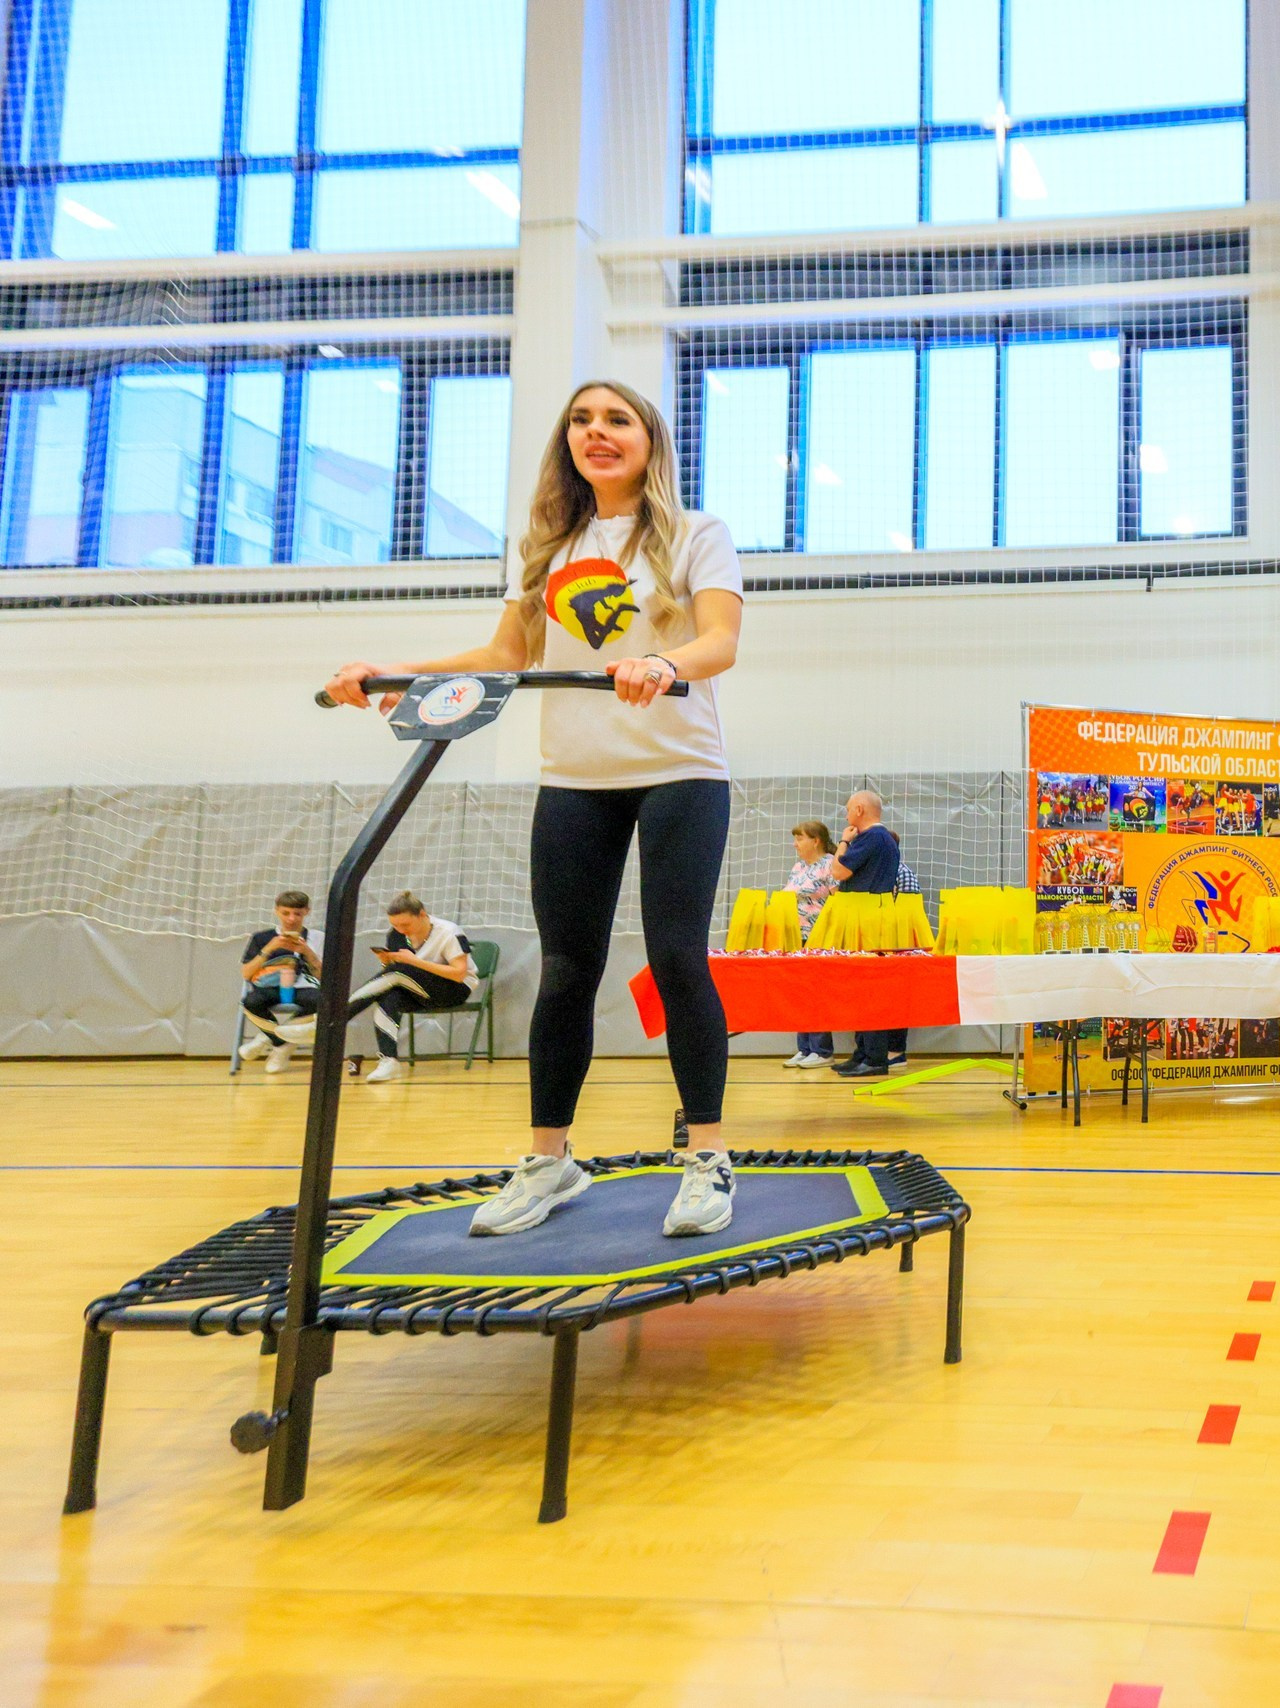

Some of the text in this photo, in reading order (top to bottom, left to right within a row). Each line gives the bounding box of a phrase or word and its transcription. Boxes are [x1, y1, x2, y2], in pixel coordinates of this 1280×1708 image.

[1077, 721, 1179, 746] ФЕДЕРАЦИЯ
[1181, 727, 1274, 751] ДЖАМПИНГ
[1137, 751, 1221, 776] ТУЛЬСКОЙ
[1148, 859, 1178, 909] ФЕДЕРАЦИЯ
[1179, 845, 1230, 862] ДЖАМПИНГ
[1231, 849, 1266, 877] ФИТНЕСА
[1265, 877, 1278, 897] РОСС
[1057, 886, 1084, 894] КУБОК
[1148, 1066, 1211, 1080] "ФЕДЕРАЦИЯ
[1213, 1064, 1268, 1079] ДЖАМПИНГ
